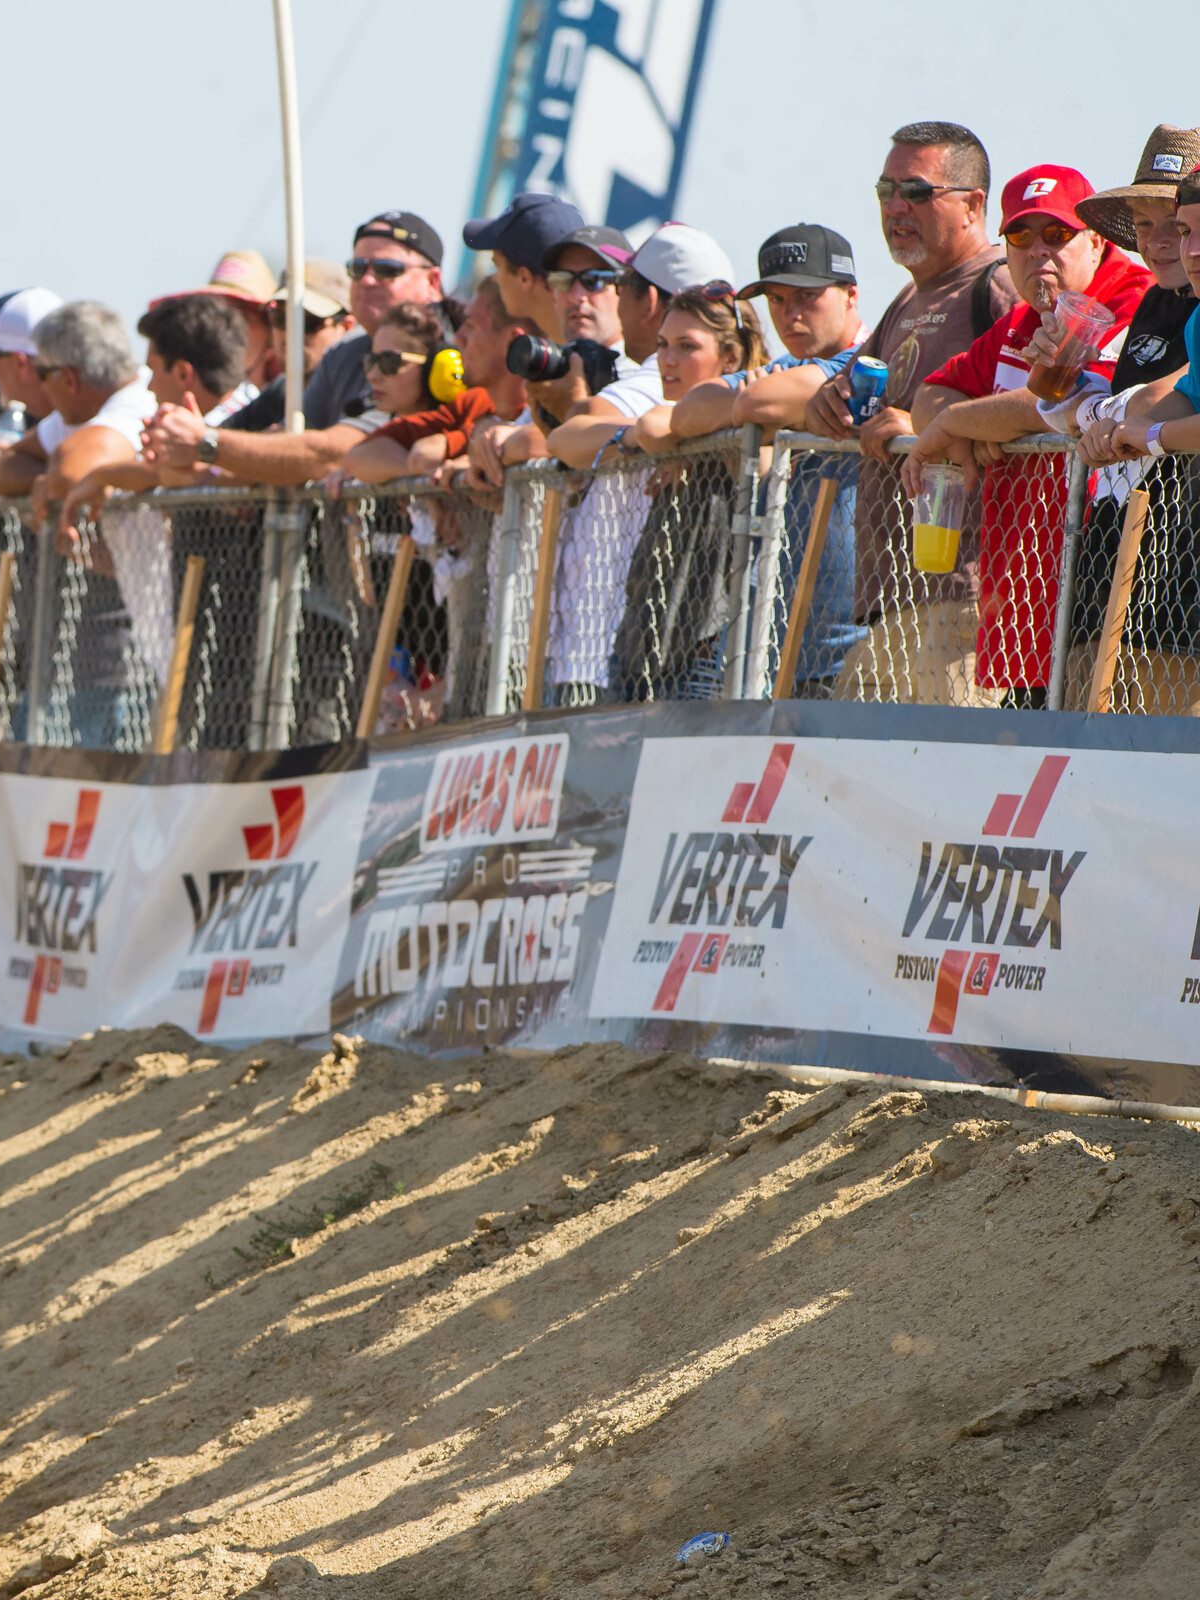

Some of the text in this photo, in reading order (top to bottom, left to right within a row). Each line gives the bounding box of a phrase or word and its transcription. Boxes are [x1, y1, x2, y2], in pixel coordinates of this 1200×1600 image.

[425, 743, 562, 841] LUCAS OIL
[182, 861, 319, 956] VERTEX
[448, 853, 517, 885] PRO
[648, 832, 814, 929] VERTEX
[901, 841, 1088, 950] VERTEX
[354, 893, 589, 998] MOTOCROSS
[633, 938, 765, 968] PISTON & POWER
[894, 954, 1046, 992] PISTON & POWER
